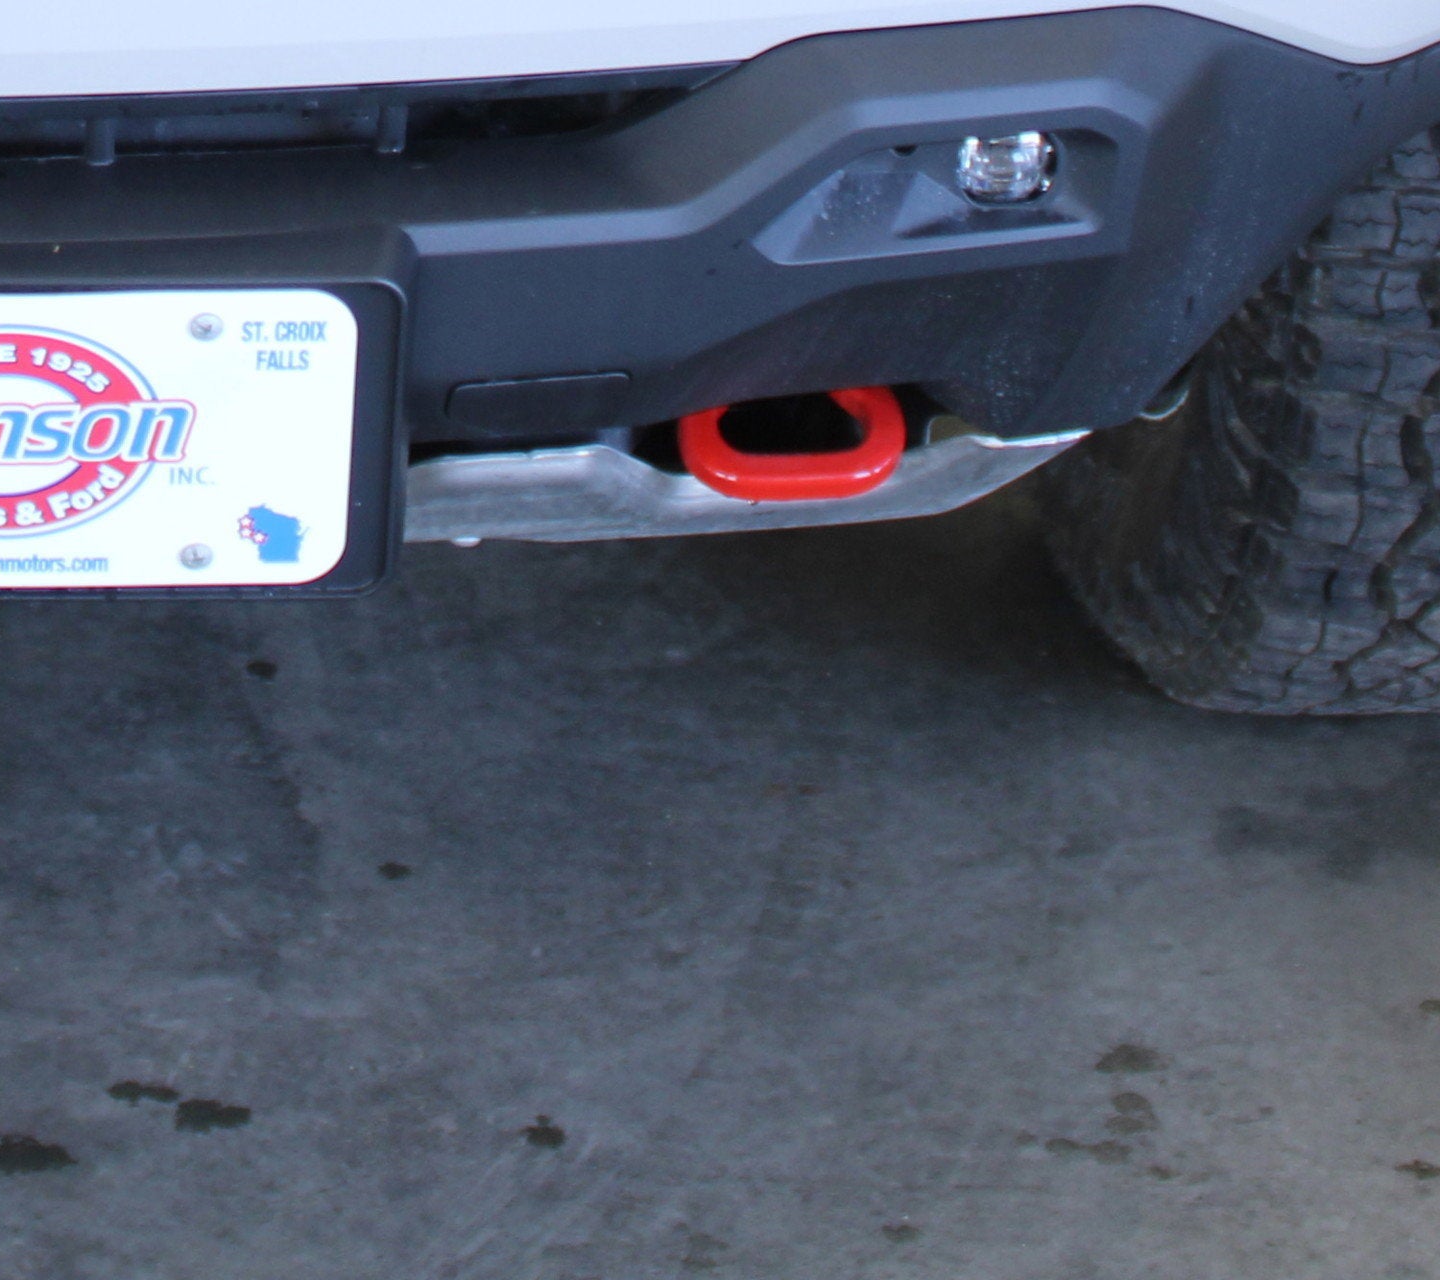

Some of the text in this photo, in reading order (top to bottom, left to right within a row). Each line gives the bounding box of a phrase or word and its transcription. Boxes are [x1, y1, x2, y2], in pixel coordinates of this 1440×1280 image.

[241, 321, 327, 341] ST. CROIX
[256, 349, 309, 370] FALLS
[31, 347, 111, 394] 1925
[169, 466, 216, 486] INC.
[15, 500, 44, 526] &
[47, 463, 127, 520] Ford
